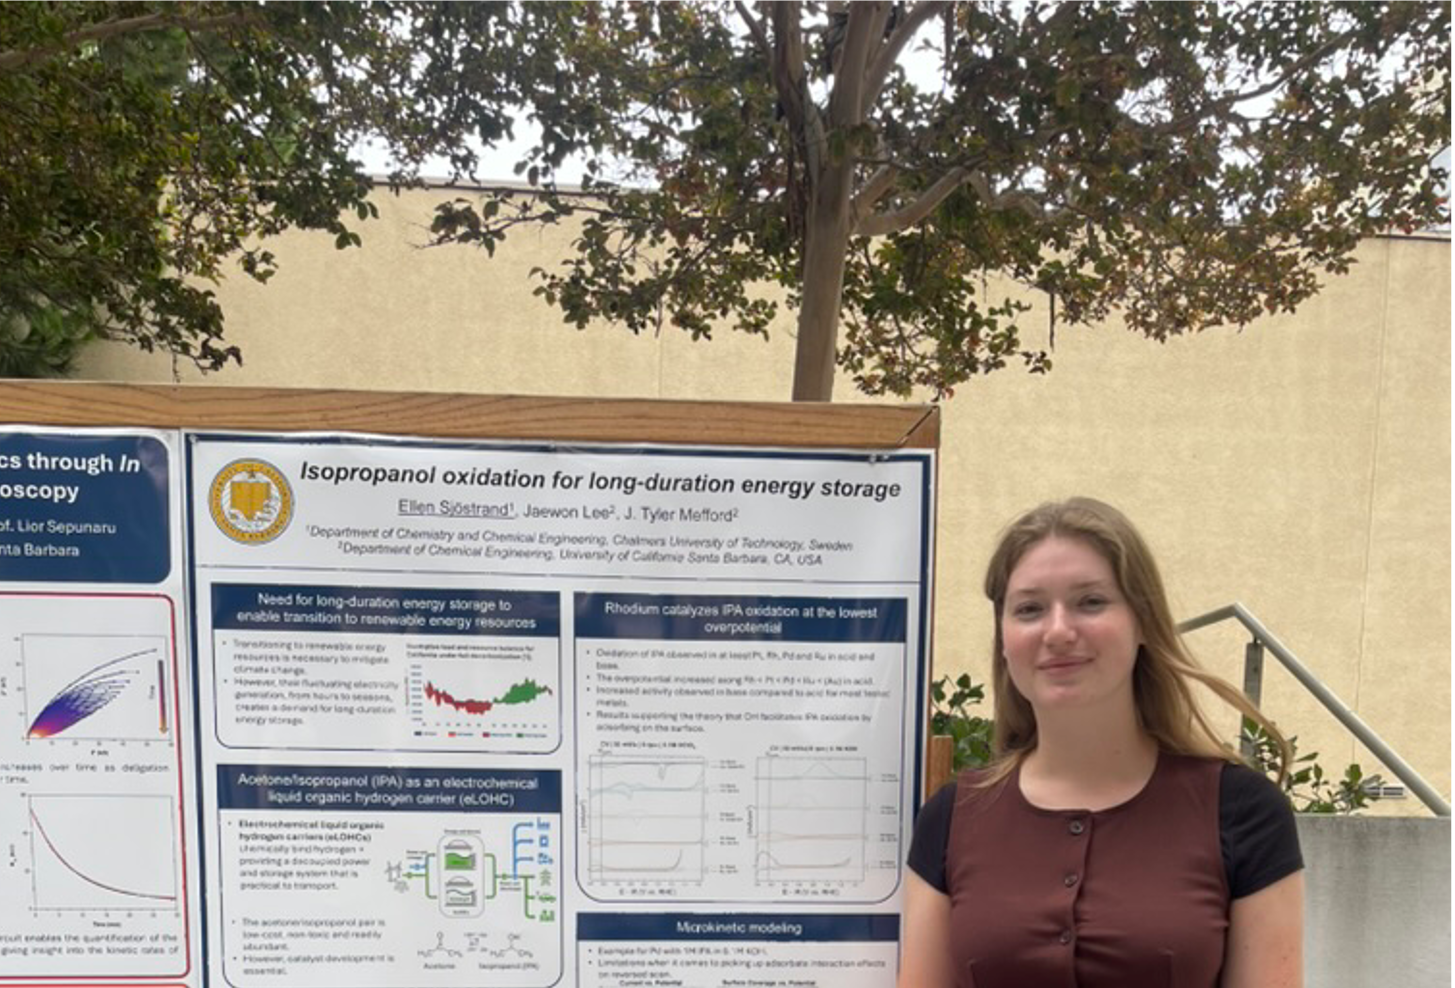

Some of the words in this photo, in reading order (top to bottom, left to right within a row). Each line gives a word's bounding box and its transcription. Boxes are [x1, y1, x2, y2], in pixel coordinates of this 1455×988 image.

[26, 453, 113, 476] through
[119, 455, 140, 472] In
[300, 462, 436, 488] Isopropanol
[442, 466, 545, 487] oxidation
[552, 469, 582, 488] for
[589, 470, 734, 497] long-duration
[741, 479, 814, 499] energy
[821, 477, 900, 502] storage
[398, 499, 435, 516] Ellen
[523, 503, 579, 518] Jaewon
[641, 506, 675, 524] Tyler
[17, 520, 43, 533] Lior
[47, 520, 116, 536] Sepunaru
[381, 527, 394, 540] of
[395, 527, 454, 544] Chemistry
[457, 529, 479, 542] and
[481, 529, 536, 543] Chemical
[538, 531, 609, 548] Engineering,
[612, 533, 666, 547] Chalmers
[669, 534, 724, 551] University
[726, 536, 738, 548] of
[741, 536, 806, 553] Technology,
[808, 538, 853, 551] Sweden
[23, 543, 79, 556] Barbara
[413, 543, 425, 556] of
[427, 544, 482, 557] Chemical
[484, 545, 555, 562] Engineering,
[559, 547, 614, 564] University
[617, 548, 630, 561] of
[631, 549, 684, 562] California
[687, 550, 719, 563] Santa
[723, 551, 770, 567] Barbara,
[773, 552, 793, 568] CA,
[796, 552, 822, 565] USA
[258, 593, 292, 606] Need
[295, 594, 312, 606] for
[316, 595, 399, 611] long-duration
[402, 599, 445, 612] energy
[449, 598, 495, 613] storage
[498, 599, 511, 611] to
[605, 602, 659, 615] Rhodium
[661, 603, 718, 618] catalyzes
[721, 604, 743, 616] IPA
[745, 604, 799, 617] oxidation
[802, 605, 813, 617] at
[816, 606, 835, 618] the
[838, 606, 877, 618] lowest
[236, 610, 280, 623] enable
[283, 611, 341, 624] transition
[344, 613, 357, 625] to
[360, 613, 425, 626] renewable
[428, 617, 471, 630] energy
[474, 618, 536, 629] resources
[703, 621, 783, 636] overpotential
[237, 774, 368, 790] Acetone/Isopropanol
[371, 776, 403, 790] (IPA)
[406, 778, 421, 787] as
[424, 779, 441, 788] an
[443, 776, 538, 789] electrochemical
[267, 791, 301, 805] liquid
[305, 791, 351, 806] organic
[354, 792, 413, 806] hydrogen
[416, 792, 455, 804] carrier
[458, 793, 514, 807] (eLOHC)
[238, 819, 318, 828] Electrochemical
[320, 819, 348, 831] liquid
[349, 819, 384, 831] organic
[238, 831, 284, 843] hydrogen
[285, 832, 323, 841] carriers
[324, 832, 371, 843] (eLOHCs)
[676, 921, 745, 933] Microkinetic
[748, 921, 802, 936] modeling
